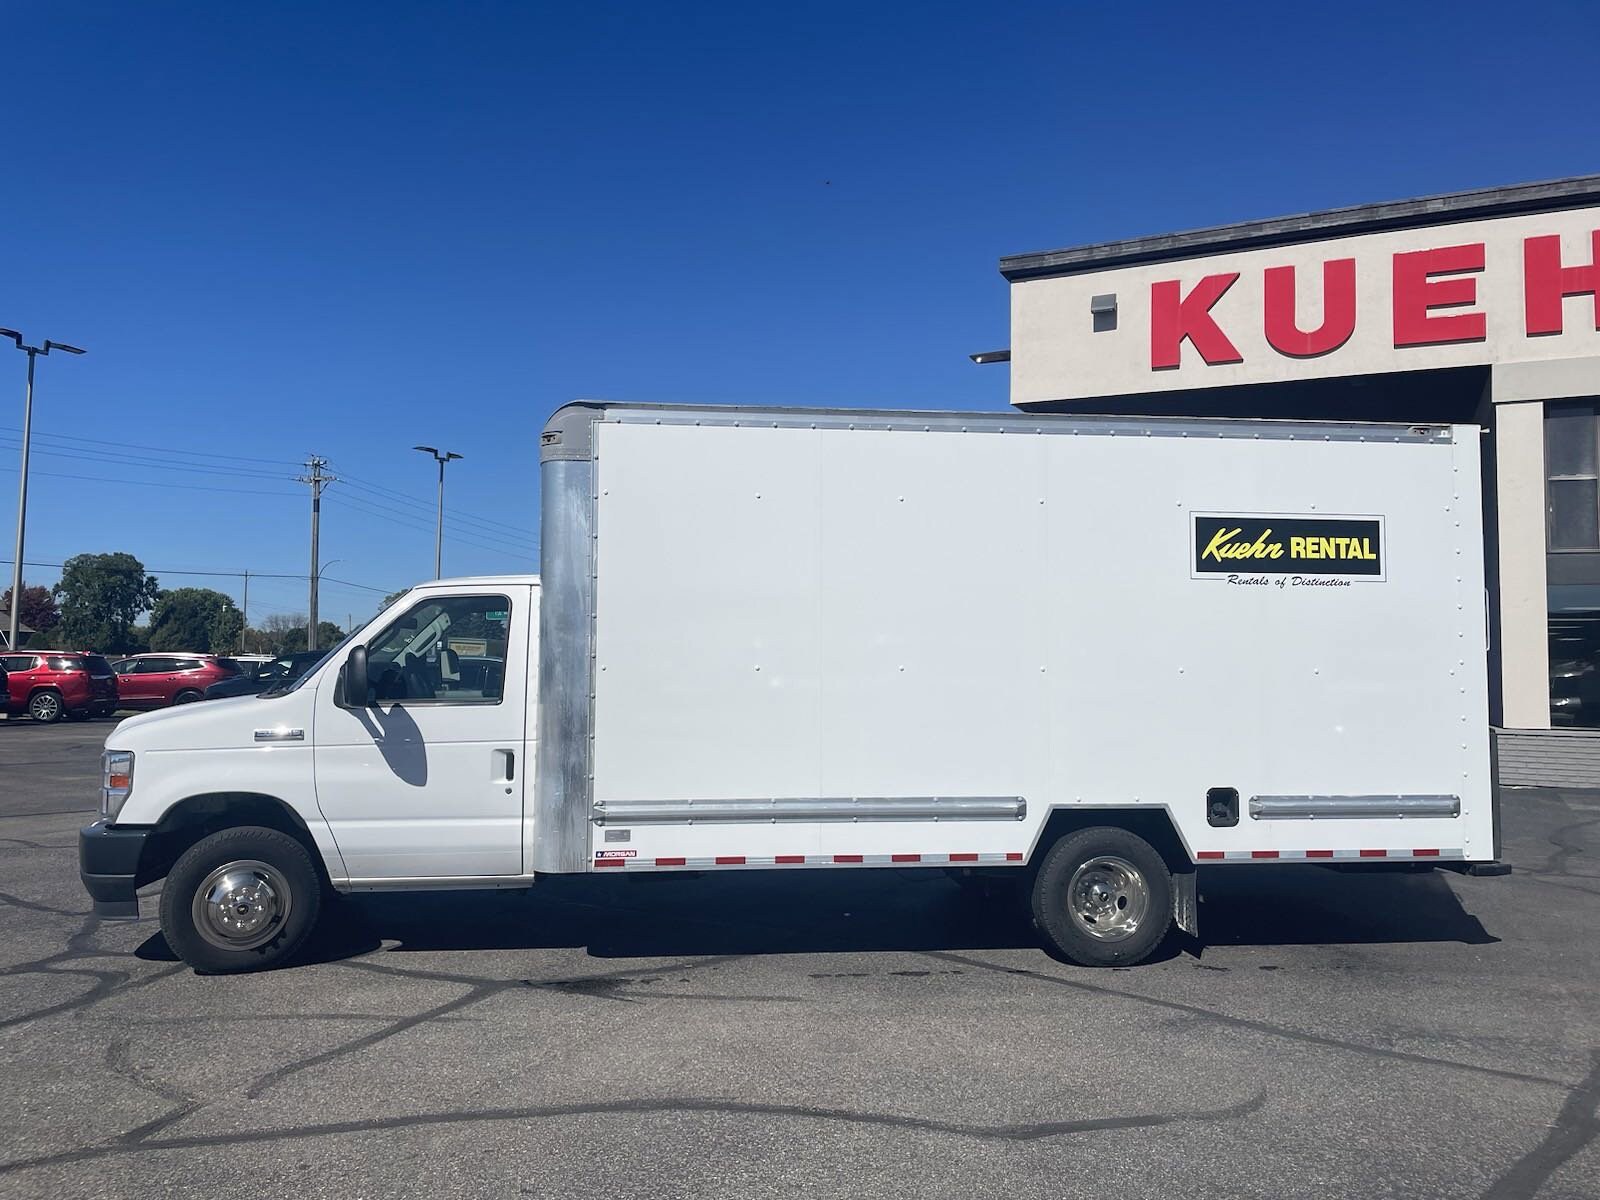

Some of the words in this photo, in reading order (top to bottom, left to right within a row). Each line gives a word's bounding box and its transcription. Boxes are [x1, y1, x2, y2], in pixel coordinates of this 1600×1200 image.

[1151, 229, 1600, 371] KUEH
[1201, 527, 1285, 563] Kuehn
[1290, 536, 1377, 560] RENTAL
[1227, 574, 1270, 587] Rentals
[1274, 576, 1286, 589] of
[1291, 576, 1352, 588] Distinction
